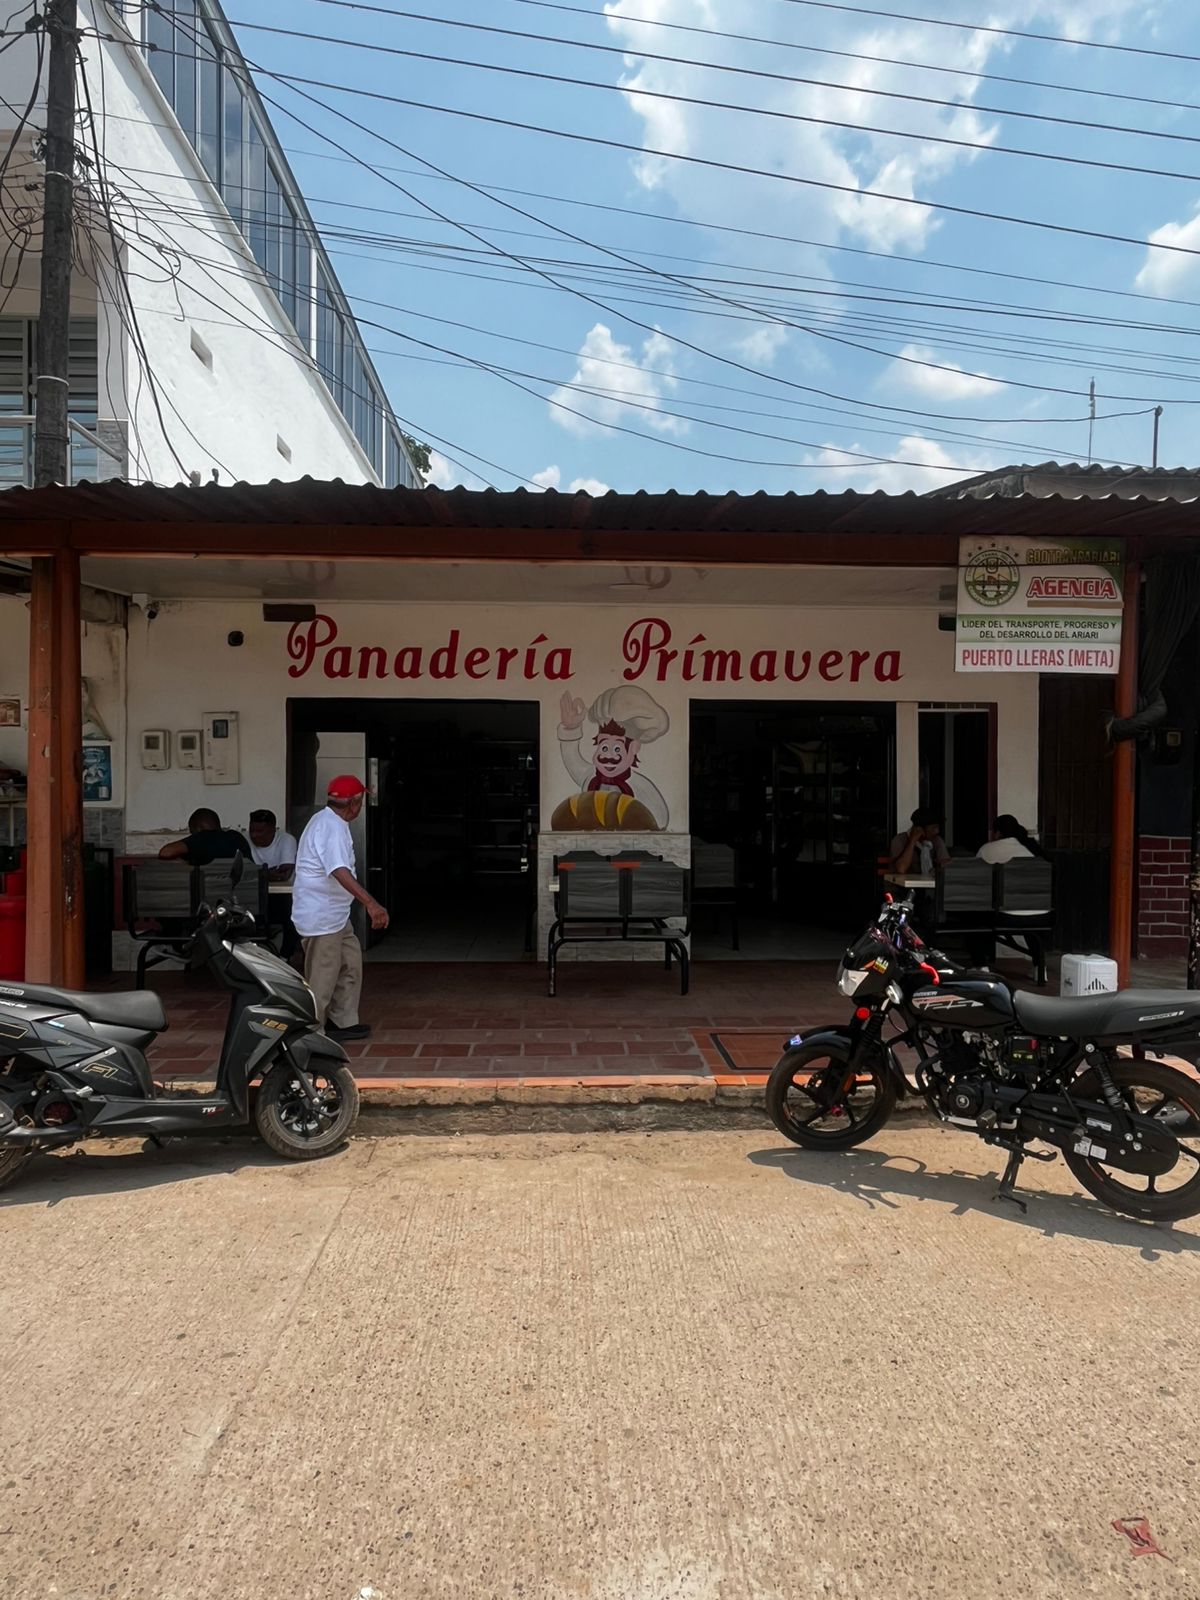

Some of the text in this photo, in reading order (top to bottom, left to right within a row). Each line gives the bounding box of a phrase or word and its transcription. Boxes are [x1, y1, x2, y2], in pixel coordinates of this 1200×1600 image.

[1027, 577, 1118, 598] AGENCIA
[962, 620, 986, 629] LIDER
[988, 620, 1003, 629] DEL
[1064, 621, 1109, 629] PROGRESO
[1110, 621, 1117, 629] Y
[980, 630, 1099, 639] DEL DESARROLLO DEL ARIARI
[287, 614, 576, 680] Panadería
[962, 649, 1013, 666] PUERTO
[1016, 649, 1065, 666] LLERAS
